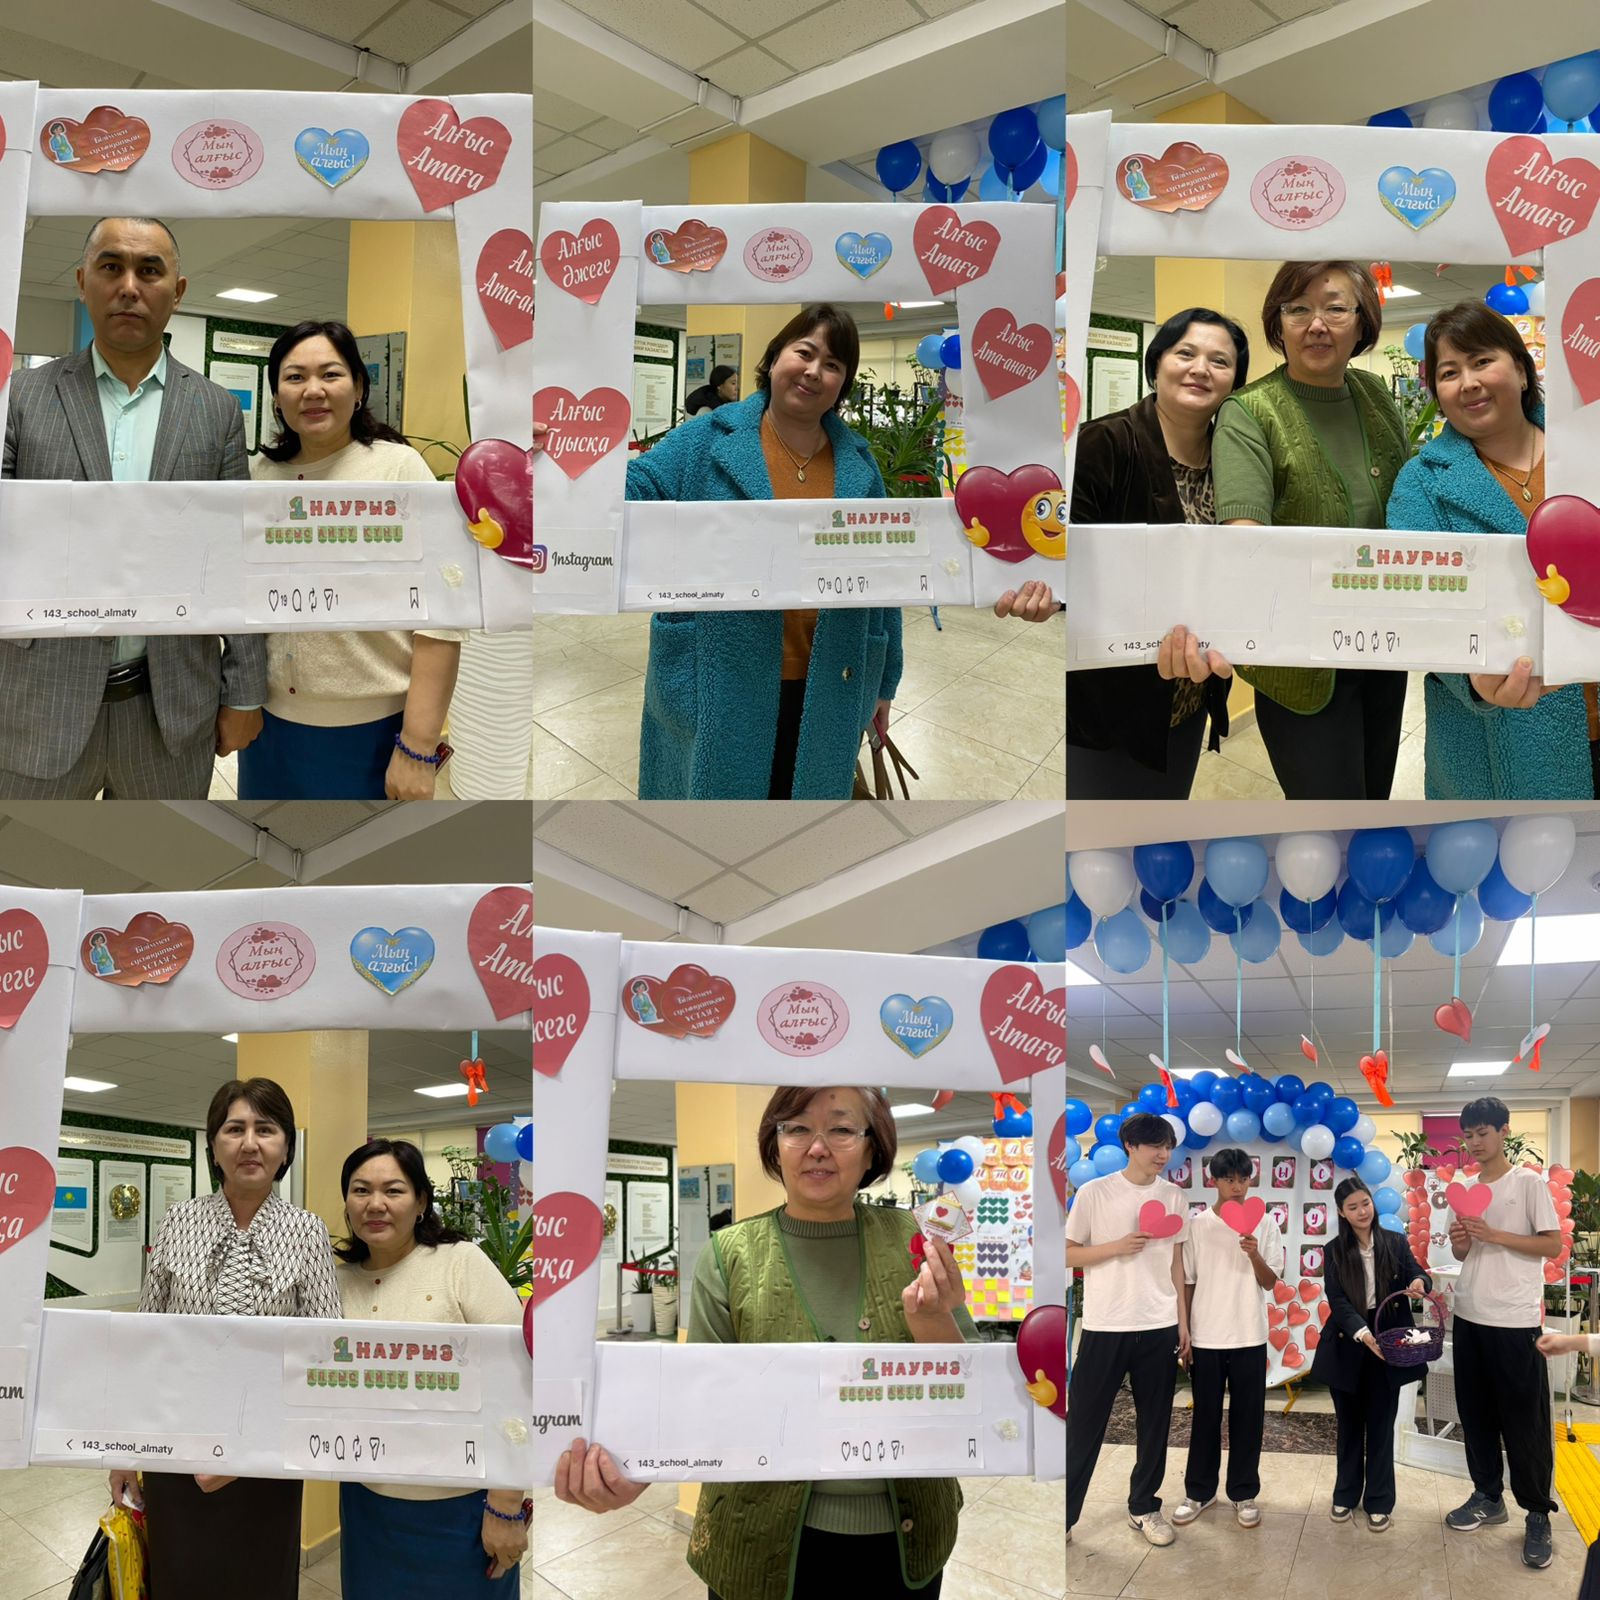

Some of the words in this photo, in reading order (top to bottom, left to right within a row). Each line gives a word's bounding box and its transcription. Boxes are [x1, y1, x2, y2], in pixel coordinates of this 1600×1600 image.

[424, 114, 494, 156] Алғыс
[202, 141, 234, 151] Мың
[314, 142, 348, 157] Мың
[194, 151, 242, 163] алғыс
[408, 146, 484, 190] Атаға
[1514, 152, 1587, 199] Алғыс
[1282, 178, 1314, 189] Мың
[1398, 182, 1433, 198] Мың
[1274, 190, 1324, 202] алғыс
[1496, 186, 1575, 236] Атаға
[934, 218, 987, 252] Алғыс
[558, 233, 602, 260] Алғыс
[766, 244, 790, 252] Мың
[850, 244, 876, 254] Мың
[760, 252, 796, 262] алғыс
[921, 244, 980, 278] Атаға
[563, 258, 611, 287] Әжеге
[996, 324, 1034, 352] Алғыс
[974, 342, 1037, 380] Ата-анаға
[550, 398, 606, 422] Алғыс
[546, 428, 610, 460] Туысқа
[289, 496, 308, 520] 1
[310, 500, 396, 516] НАУРЫЗ
[832, 510, 845, 528] 1
[847, 512, 911, 524] НАУРЫЗ
[552, 552, 614, 572] Instagram
[1357, 545, 1374, 567] 1
[1377, 550, 1463, 566] НАУРЫЗ
[658, 591, 724, 600] 143_school_almaty
[43, 608, 136, 619] 143_school_almaty
[249, 945, 282, 957] Мың
[372, 944, 410, 962] Мың
[241, 957, 292, 972] алғыс
[788, 1004, 819, 1014] Мың
[899, 1010, 932, 1026] Мың
[780, 1017, 828, 1028] алғыс
[990, 1016, 1062, 1064] Атаға
[334, 1336, 353, 1362] 1
[356, 1342, 453, 1362] НАУРЫЗ
[862, 1358, 879, 1380] 1
[882, 1361, 960, 1376] НАУРЫЗ
[82, 1440, 173, 1454] 143_school_almaty
[322, 1441, 330, 1453] 19
[638, 1458, 722, 1468] 143_school_almaty
